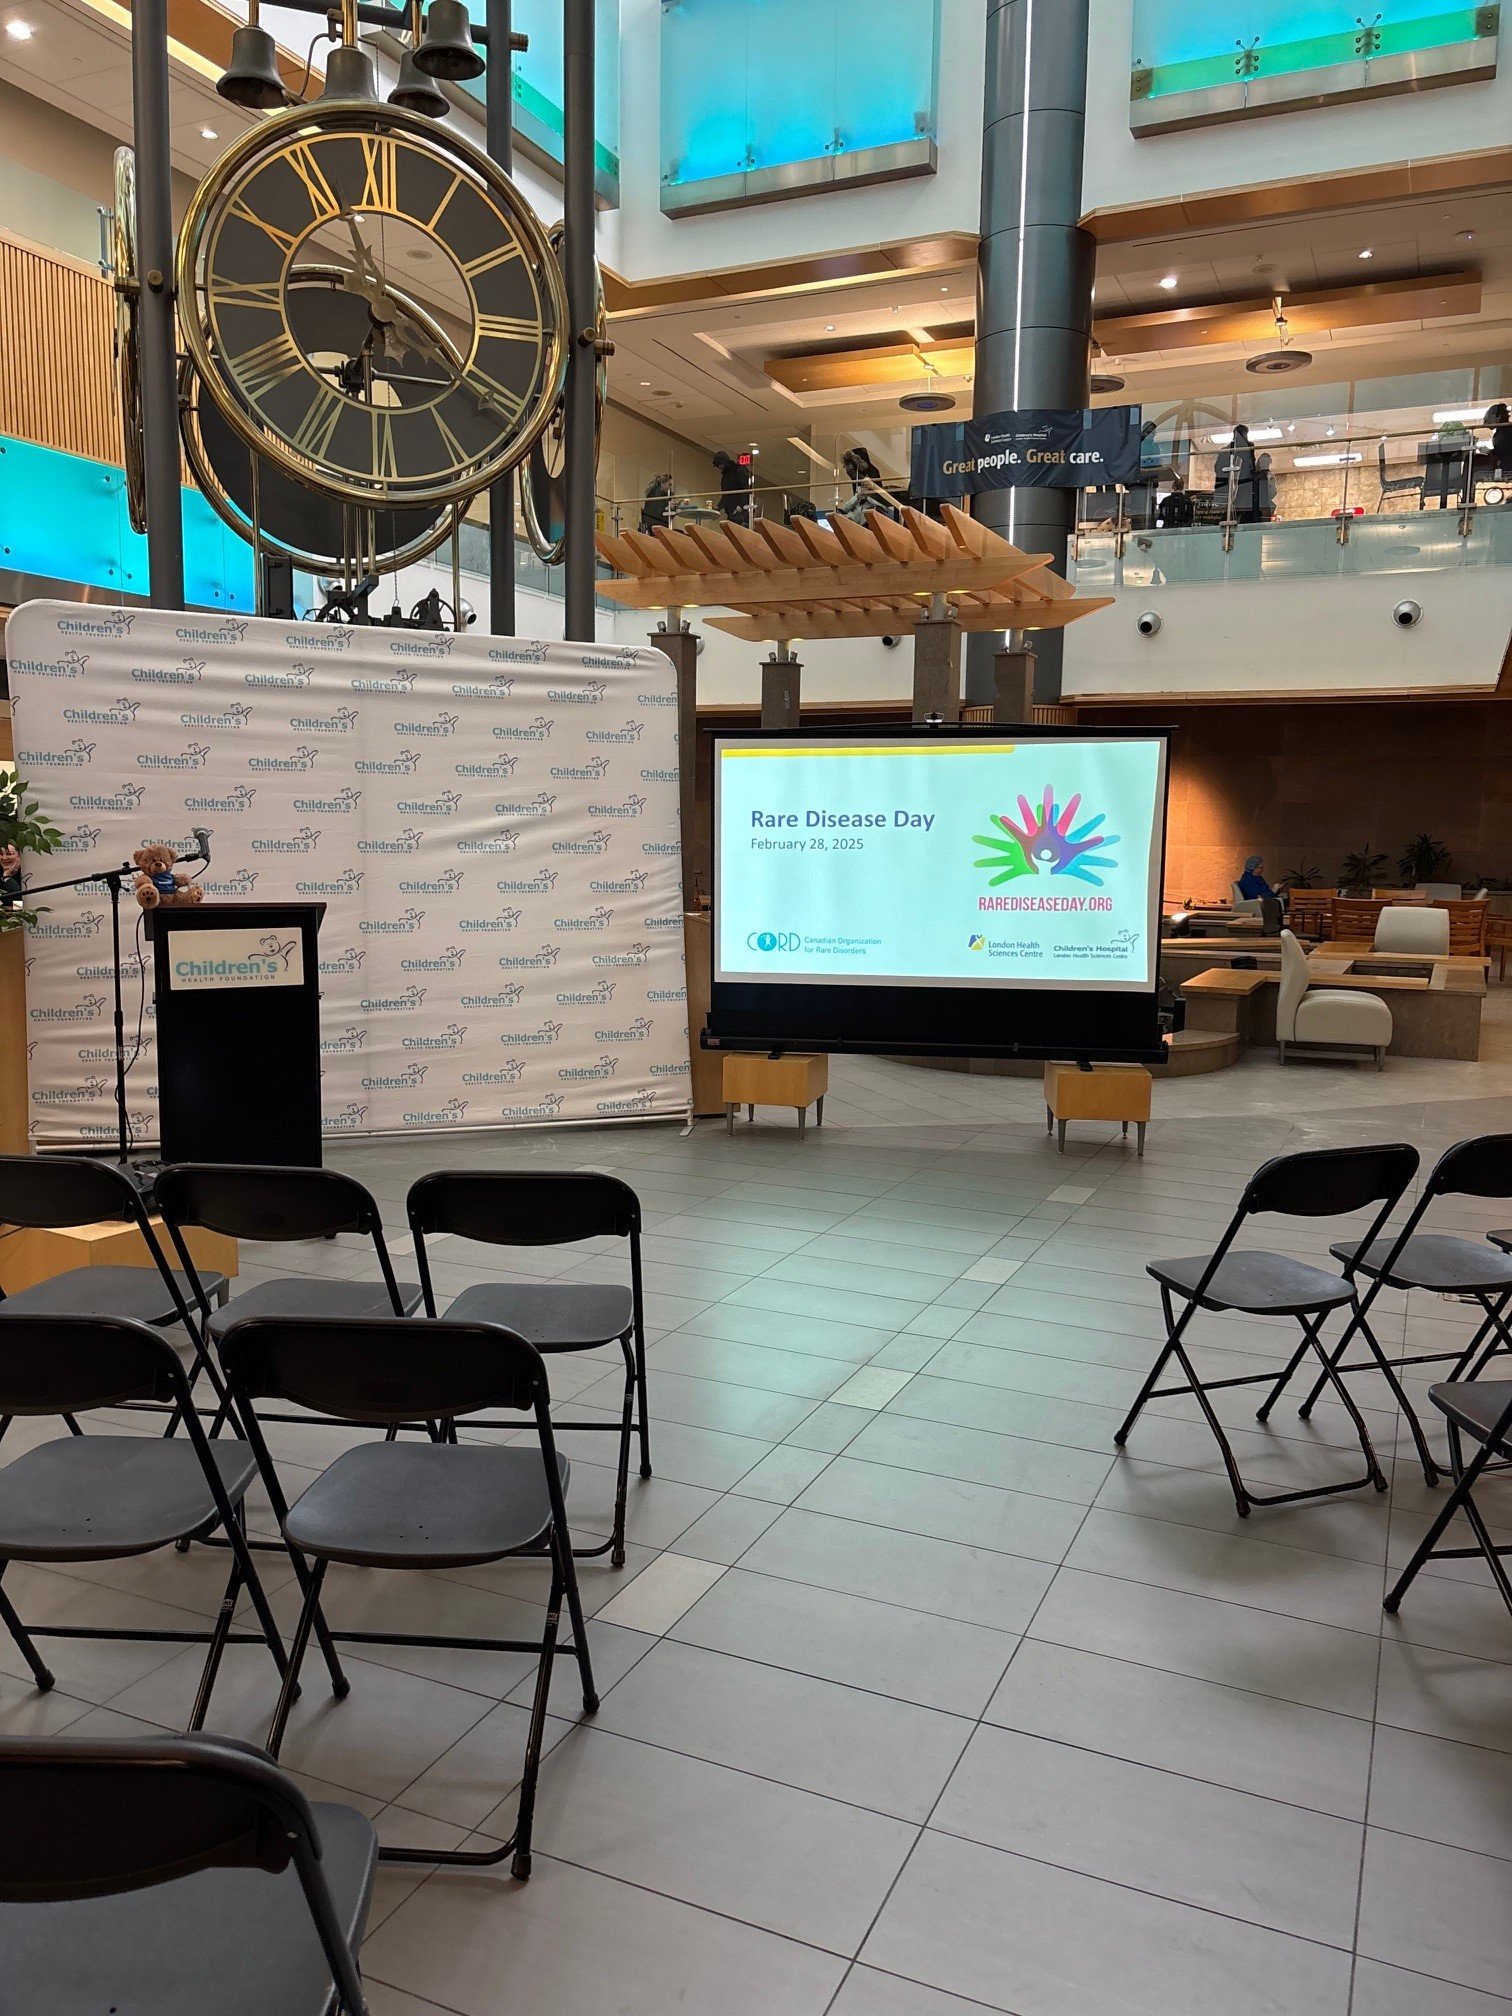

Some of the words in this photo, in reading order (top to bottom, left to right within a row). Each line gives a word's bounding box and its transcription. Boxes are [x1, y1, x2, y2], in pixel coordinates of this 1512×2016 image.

[942, 459, 975, 475] Great
[978, 449, 1021, 473] people.
[1026, 449, 1066, 464] Great
[1069, 450, 1104, 464] care.
[57, 620, 123, 634] Children's
[176, 628, 237, 641] Children's
[285, 635, 343, 648] Children's
[390, 642, 444, 654] Children's
[488, 650, 541, 661] Children's
[10, 659, 77, 674] Children's
[582, 657, 631, 667] Children's
[131, 668, 194, 680] Children's
[244, 674, 303, 686] Children's
[351, 680, 407, 690] Children's
[452, 685, 506, 696] Children's
[547, 690, 598, 701] Children's
[637, 695, 678, 703] Children
[63, 709, 129, 721] Children's
[180, 714, 241, 725] Children's
[289, 718, 348, 729] Children's
[394, 723, 449, 733] Children's
[492, 727, 545, 738] Children's
[586, 731, 635, 741] Children's
[18, 751, 84, 762] Children's
[136, 755, 199, 765] Children's
[248, 758, 307, 768] Children's
[354, 761, 411, 771] Children's
[455, 764, 508, 775] Children's
[550, 767, 600, 777] Children's
[640, 770, 679, 779] Children
[69, 796, 133, 807] Children's
[185, 798, 244, 808] Children's
[293, 800, 351, 810] Children's
[397, 802, 451, 812] Children's
[495, 804, 547, 814] Children's
[588, 806, 637, 815] Children's
[751, 811, 799, 828] Rare
[806, 810, 886, 828] Disease
[894, 811, 935, 831] Day
[251, 840, 310, 850] Children's
[357, 841, 413, 851] Children's
[457, 841, 510, 851] Children's
[552, 842, 602, 852] Children's
[642, 843, 681, 852] Children
[751, 839, 806, 851] February
[809, 839, 828, 851] 28,
[832, 839, 863, 850] 2025
[191, 882, 247, 891] ildren's
[295, 882, 353, 892] Children's
[399, 881, 454, 891] Children's
[497, 881, 548, 890] Children's
[590, 881, 639, 890] Children's
[978, 897, 1112, 912] RAREDISEASEDAY.ORG
[359, 921, 414, 931] Children's
[459, 920, 512, 929] Children's
[554, 918, 604, 928] Children's
[644, 917, 684, 926] Children
[27, 924, 92, 935] Children's
[838, 938, 881, 946] Organization
[989, 941, 1015, 949] London
[1017, 941, 1040, 949] Health
[401, 959, 456, 969] Children's
[499, 957, 551, 967] Children's
[592, 955, 642, 964] Children's
[176, 960, 278, 976] Children's
[319, 962, 355, 970] dren's
[76, 967, 139, 976] Childrn's
[219, 974, 276, 982] FOUNDATION
[556, 993, 607, 1003] Children's
[647, 990, 687, 999] Children
[361, 998, 416, 1008] Children's
[461, 995, 514, 1005] Children's
[30, 1008, 94, 1019] Children's
[501, 1033, 553, 1043] Children's
[594, 1030, 644, 1039] Children's
[320, 1041, 356, 1049] dren's
[402, 1037, 457, 1047] Children's
[558, 1068, 609, 1078] Children's
[649, 1064, 690, 1073] Children
[361, 1077, 417, 1087] Children's
[462, 1073, 516, 1082] Children's
[32, 1090, 95, 1101] Children's
[502, 1107, 555, 1117] Children's
[596, 1102, 647, 1112] Children's
[322, 1117, 357, 1125] dren's
[403, 1112, 458, 1122] Children's
[79, 1126, 142, 1135] Childr's
